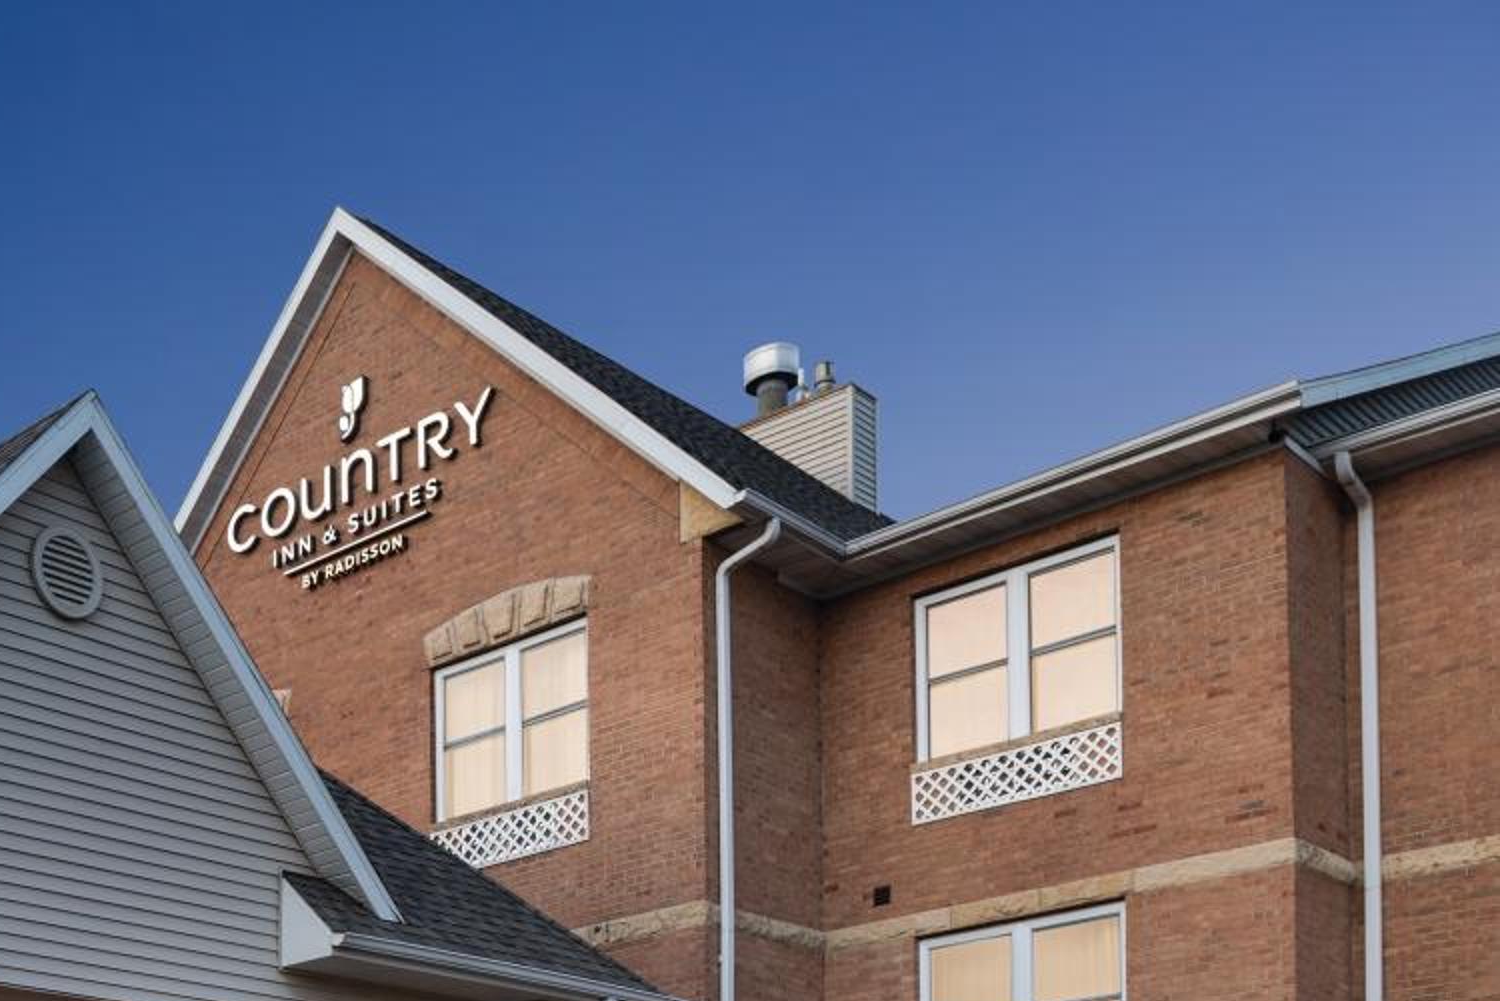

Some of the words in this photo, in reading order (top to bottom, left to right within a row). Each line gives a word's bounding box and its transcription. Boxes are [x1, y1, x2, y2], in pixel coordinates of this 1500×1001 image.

[273, 534, 313, 568] INN
[323, 524, 338, 545] &
[347, 477, 439, 533] SUITES
[301, 572, 320, 589] BY
[324, 533, 405, 579] RADISSON
